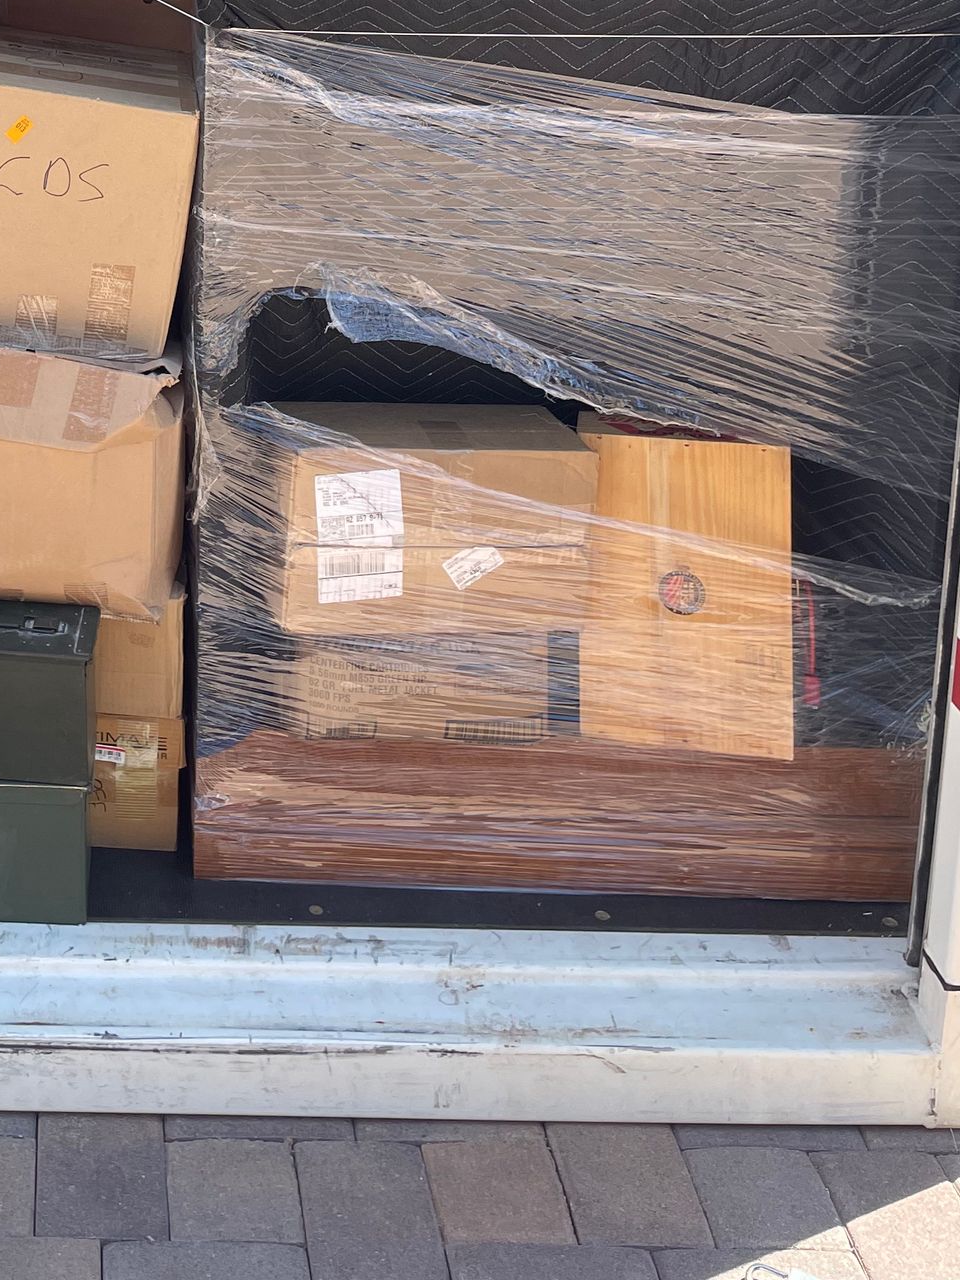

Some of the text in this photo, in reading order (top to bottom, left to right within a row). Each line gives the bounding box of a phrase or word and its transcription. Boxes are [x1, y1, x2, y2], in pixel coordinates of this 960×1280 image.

[350, 672, 375, 684] M855
[404, 685, 438, 696] JACKET
[333, 693, 351, 703] FPS
[326, 704, 359, 713] ROUNDS
